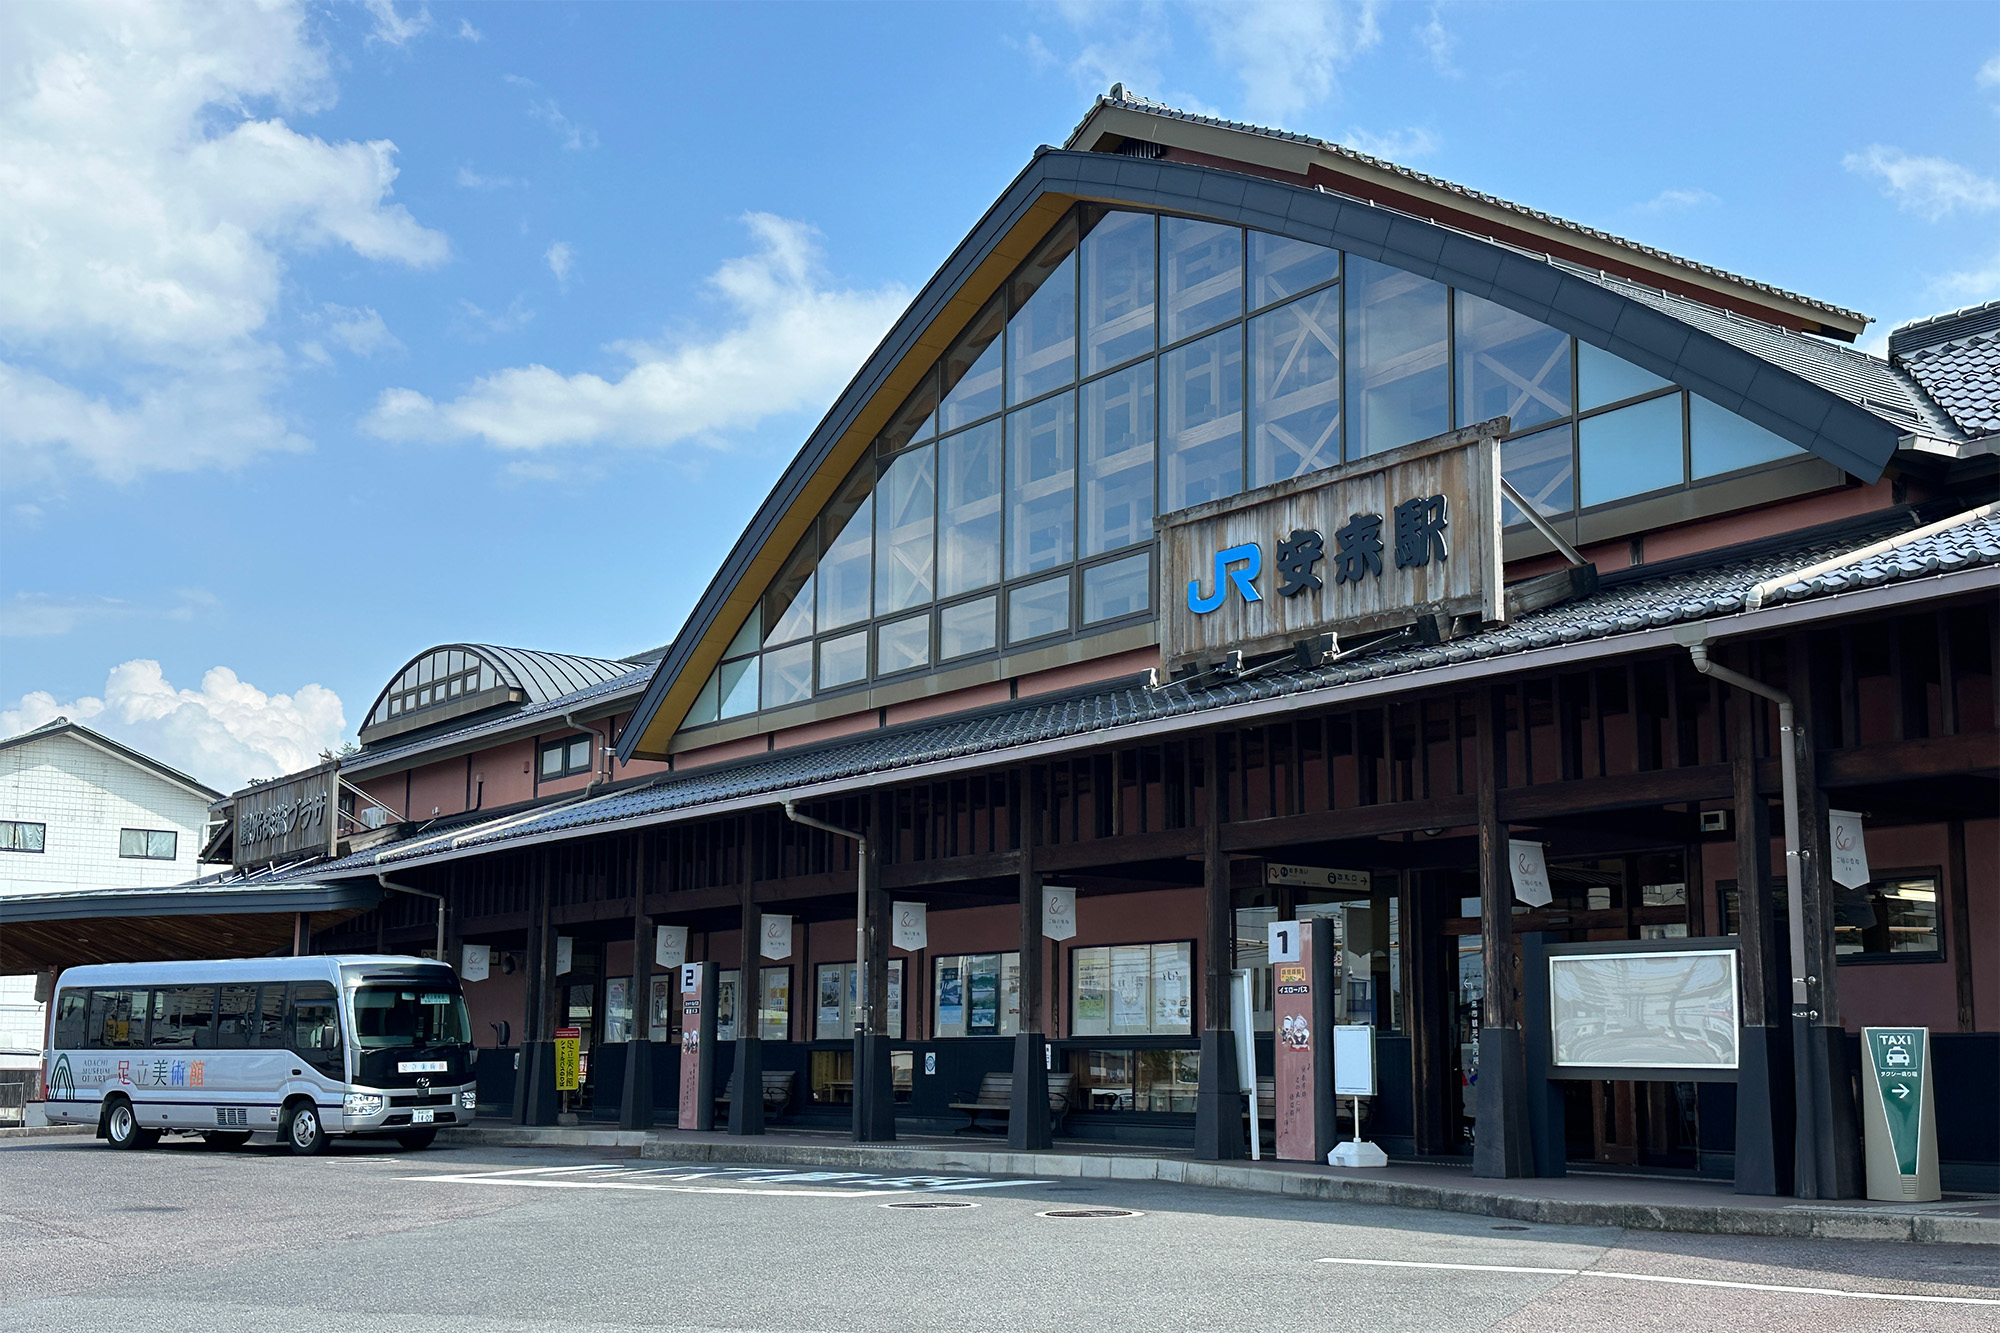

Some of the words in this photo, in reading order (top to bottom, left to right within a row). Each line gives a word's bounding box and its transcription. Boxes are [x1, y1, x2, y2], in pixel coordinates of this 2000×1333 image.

[1188, 542, 1262, 614] JR
[1276, 493, 1448, 597] 安来駅
[1277, 930, 1288, 954] 1
[685, 969, 694, 986] 2
[1278, 986, 1308, 994] イエローバス
[1879, 1035, 1911, 1045] TAXI
[117, 1059, 205, 1087] 足立美術館
